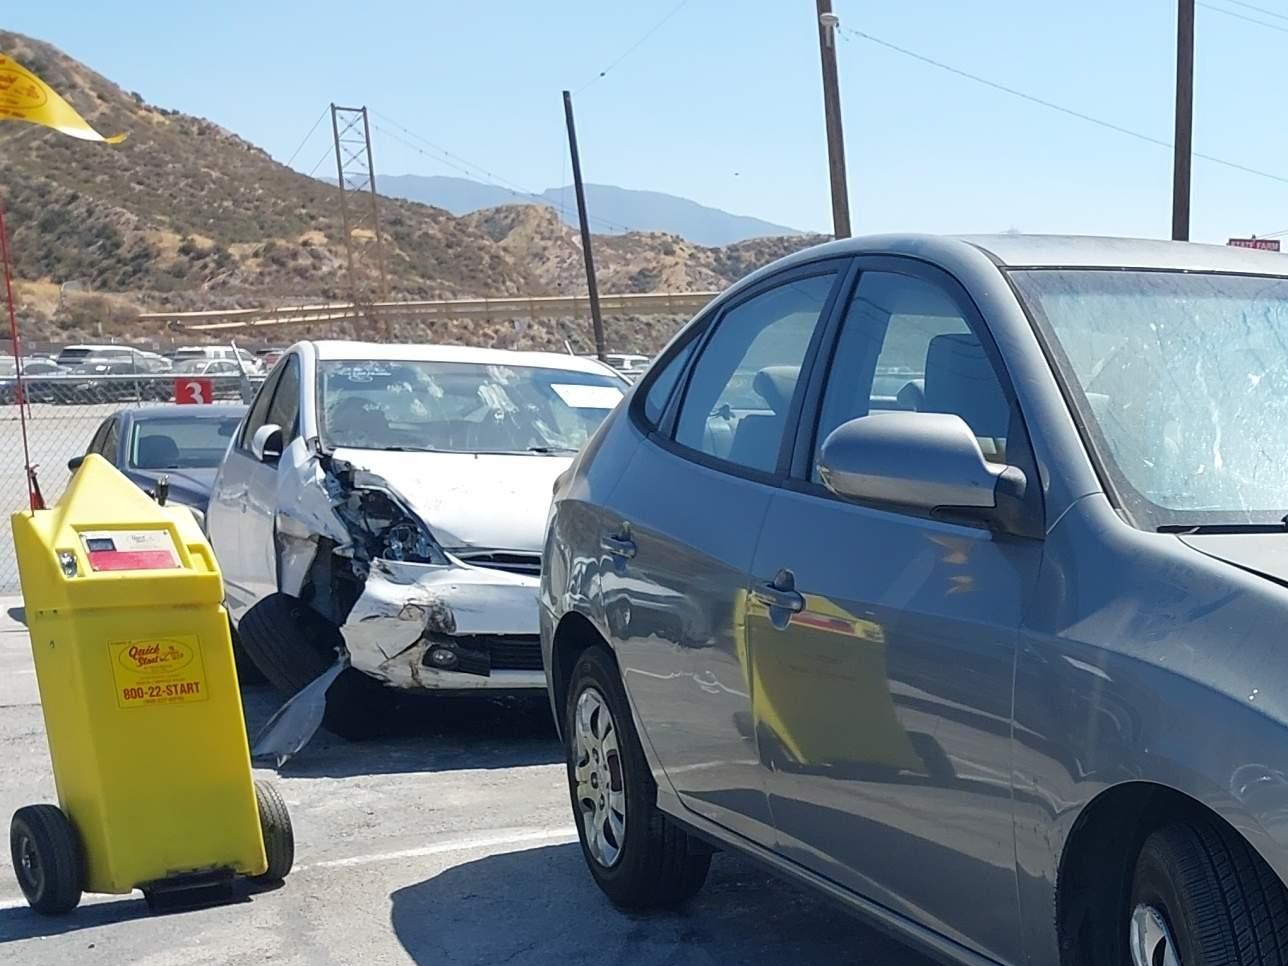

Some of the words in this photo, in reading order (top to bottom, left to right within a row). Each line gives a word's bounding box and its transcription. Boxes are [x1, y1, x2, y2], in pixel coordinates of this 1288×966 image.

[185, 382, 204, 404] 3
[128, 643, 160, 660] Quick
[123, 682, 200, 700] 800-22-START
